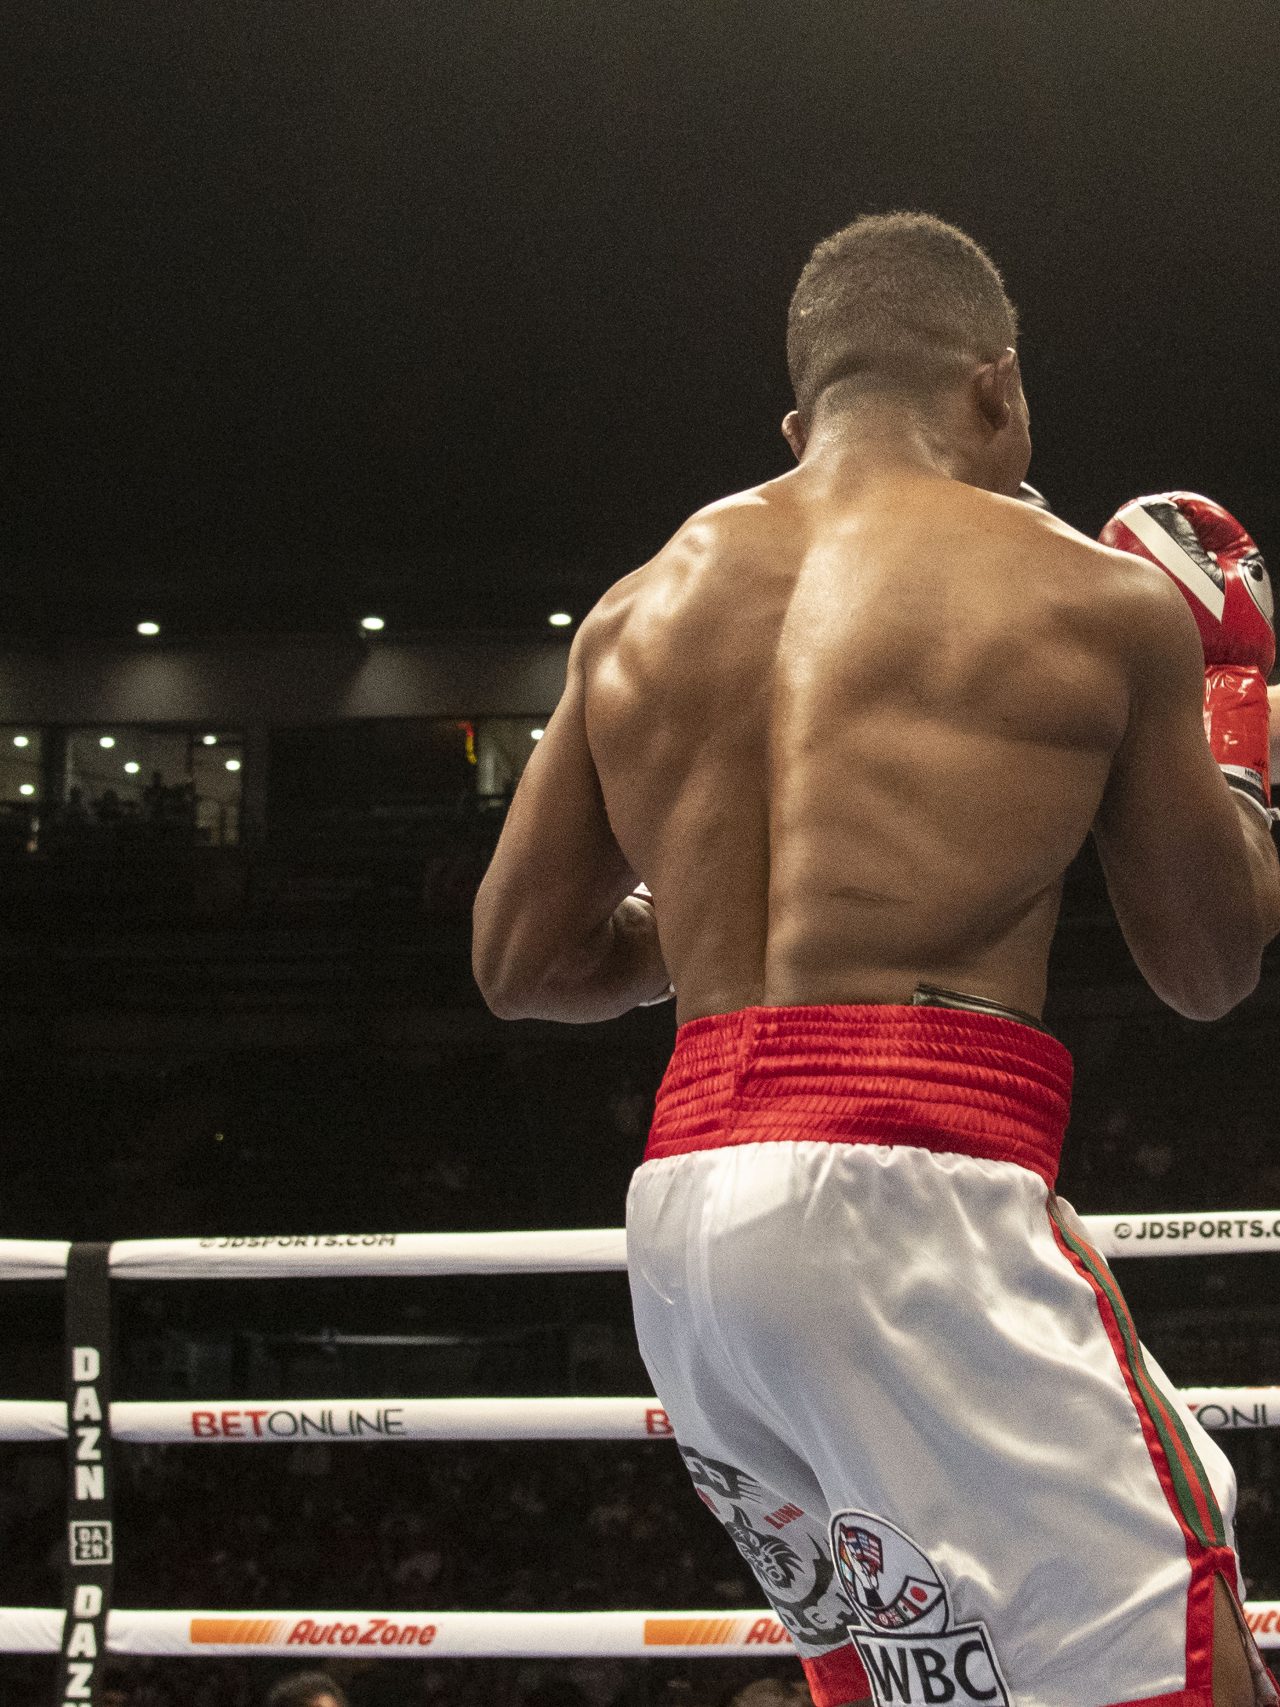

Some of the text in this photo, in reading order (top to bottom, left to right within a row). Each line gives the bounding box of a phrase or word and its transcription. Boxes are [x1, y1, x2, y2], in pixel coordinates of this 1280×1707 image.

[72, 1346, 105, 1501] DAZN
[190, 1408, 407, 1438] BETONLINE
[62, 1584, 103, 1707] DAZ
[287, 1618, 437, 1645] AutoZone
[859, 1639, 999, 1705] WBC
